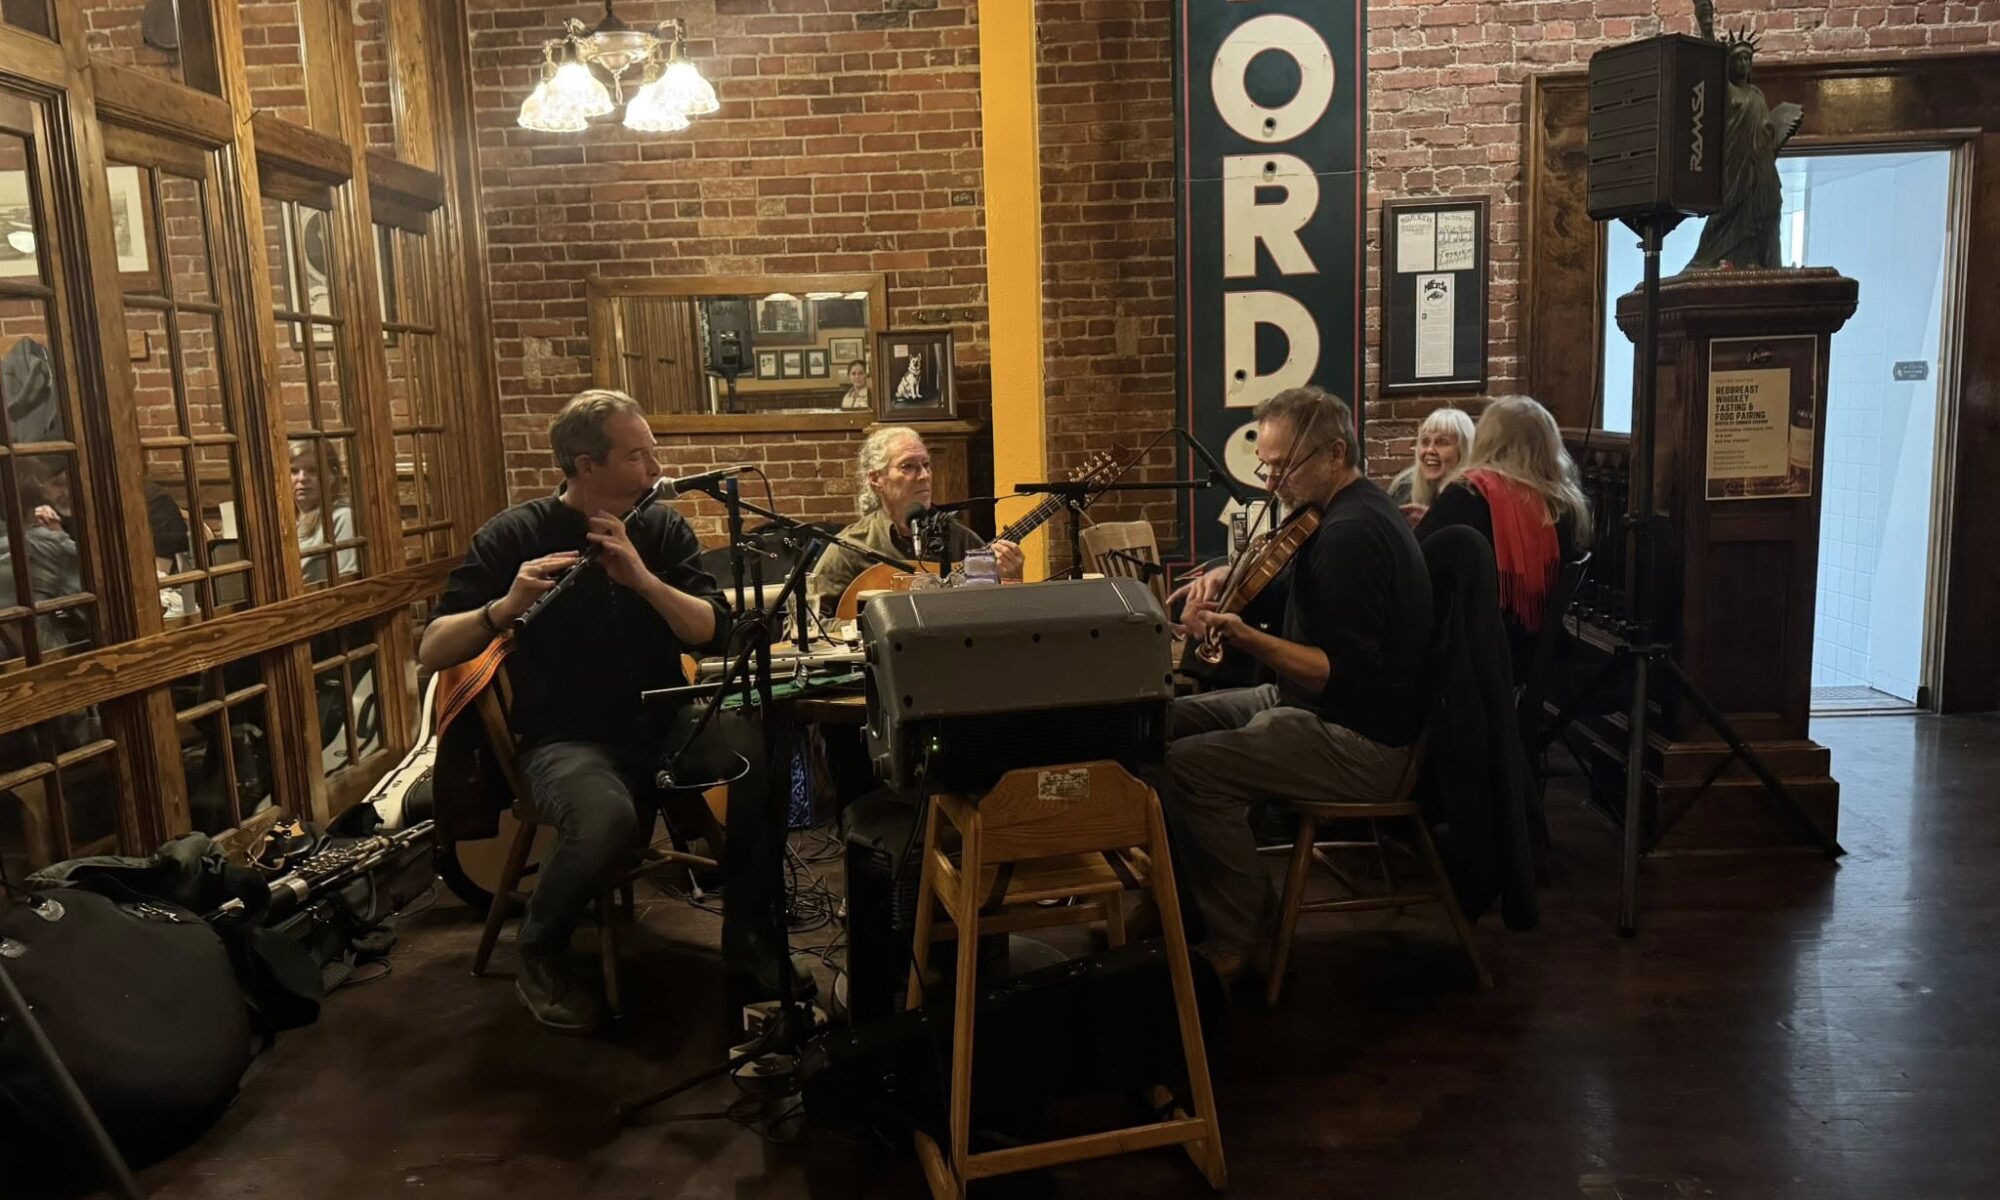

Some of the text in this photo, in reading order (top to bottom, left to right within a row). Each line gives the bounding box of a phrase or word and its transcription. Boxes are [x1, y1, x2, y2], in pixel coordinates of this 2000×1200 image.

[1689, 80, 1705, 172] RAMSA
[1716, 385, 1759, 395] REDBREAST
[1716, 394, 1749, 403] WHISKEY
[1716, 402, 1754, 412] TASTING &
[1715, 411, 1766, 421] FOOD PAIRING
